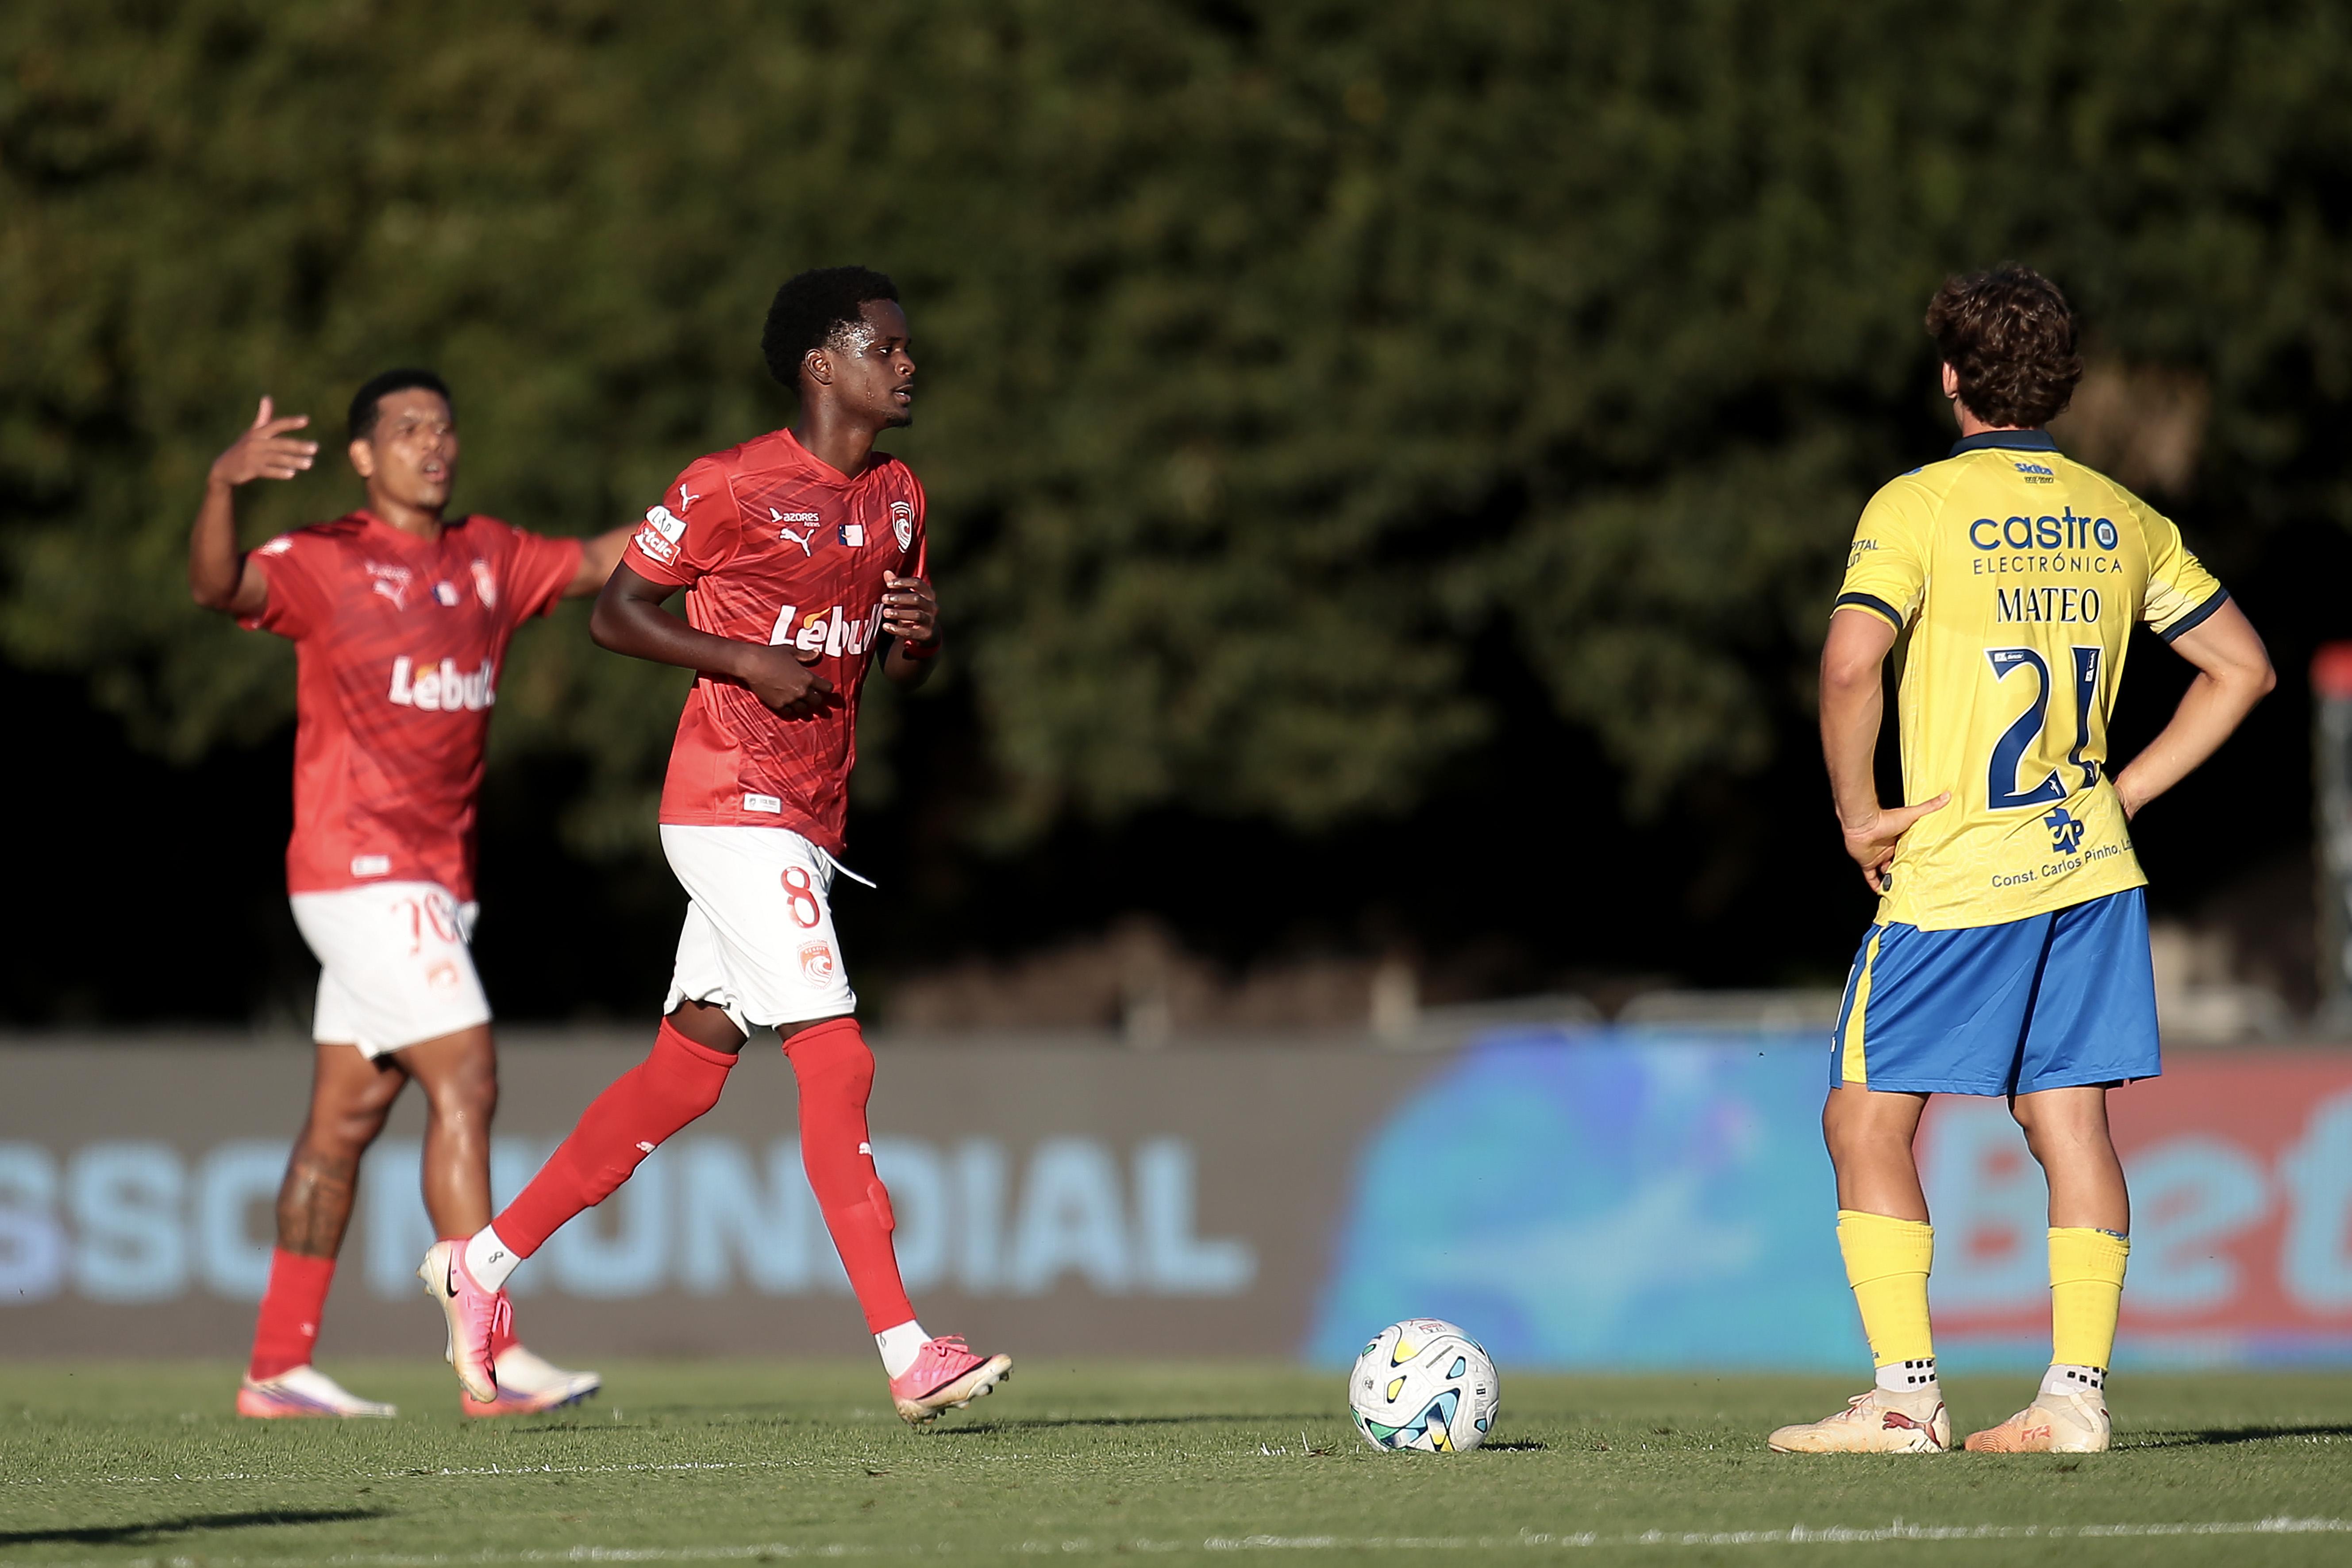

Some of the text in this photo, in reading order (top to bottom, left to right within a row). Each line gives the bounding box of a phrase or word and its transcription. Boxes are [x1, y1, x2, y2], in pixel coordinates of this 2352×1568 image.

[1970, 506, 2118, 551] castro
[1973, 552, 2123, 575] ELECTRÓNICA
[1997, 588, 2100, 623] MATEO
[1984, 645, 2103, 812] 21
[1991, 870, 2038, 888] Const.
[2041, 858, 2083, 878] Carlos
[2084, 843, 2121, 864] Pinho,
[780, 866, 820, 928] 8
